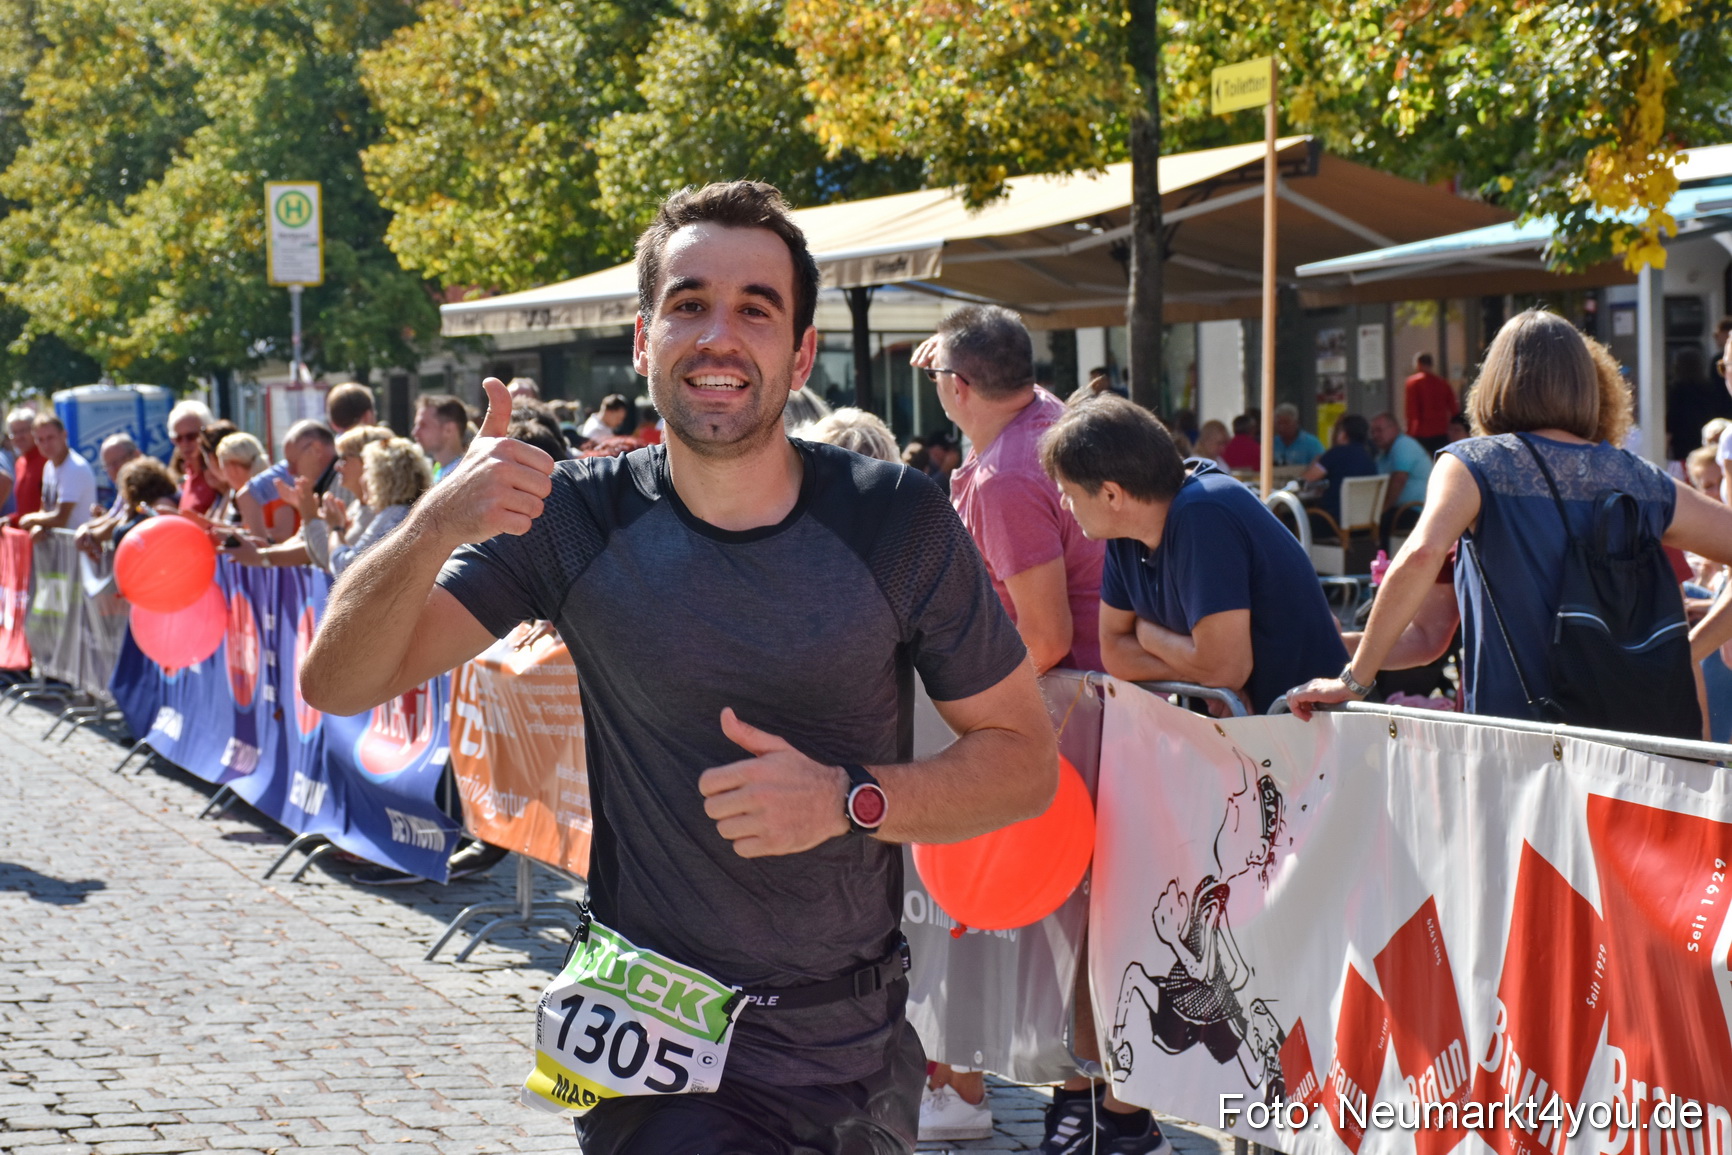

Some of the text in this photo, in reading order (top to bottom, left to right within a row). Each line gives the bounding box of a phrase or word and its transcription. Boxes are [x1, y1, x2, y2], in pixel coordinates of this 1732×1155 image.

[1223, 76, 1269, 97] Toiletten
[1687, 858, 1727, 953] Seit 1929
[1426, 918, 1437, 943] 1929
[1586, 943, 1607, 1009] Seit 1929
[557, 993, 694, 1093] 1305
[702, 1055, 714, 1065] C
[551, 1073, 601, 1106] MAR
